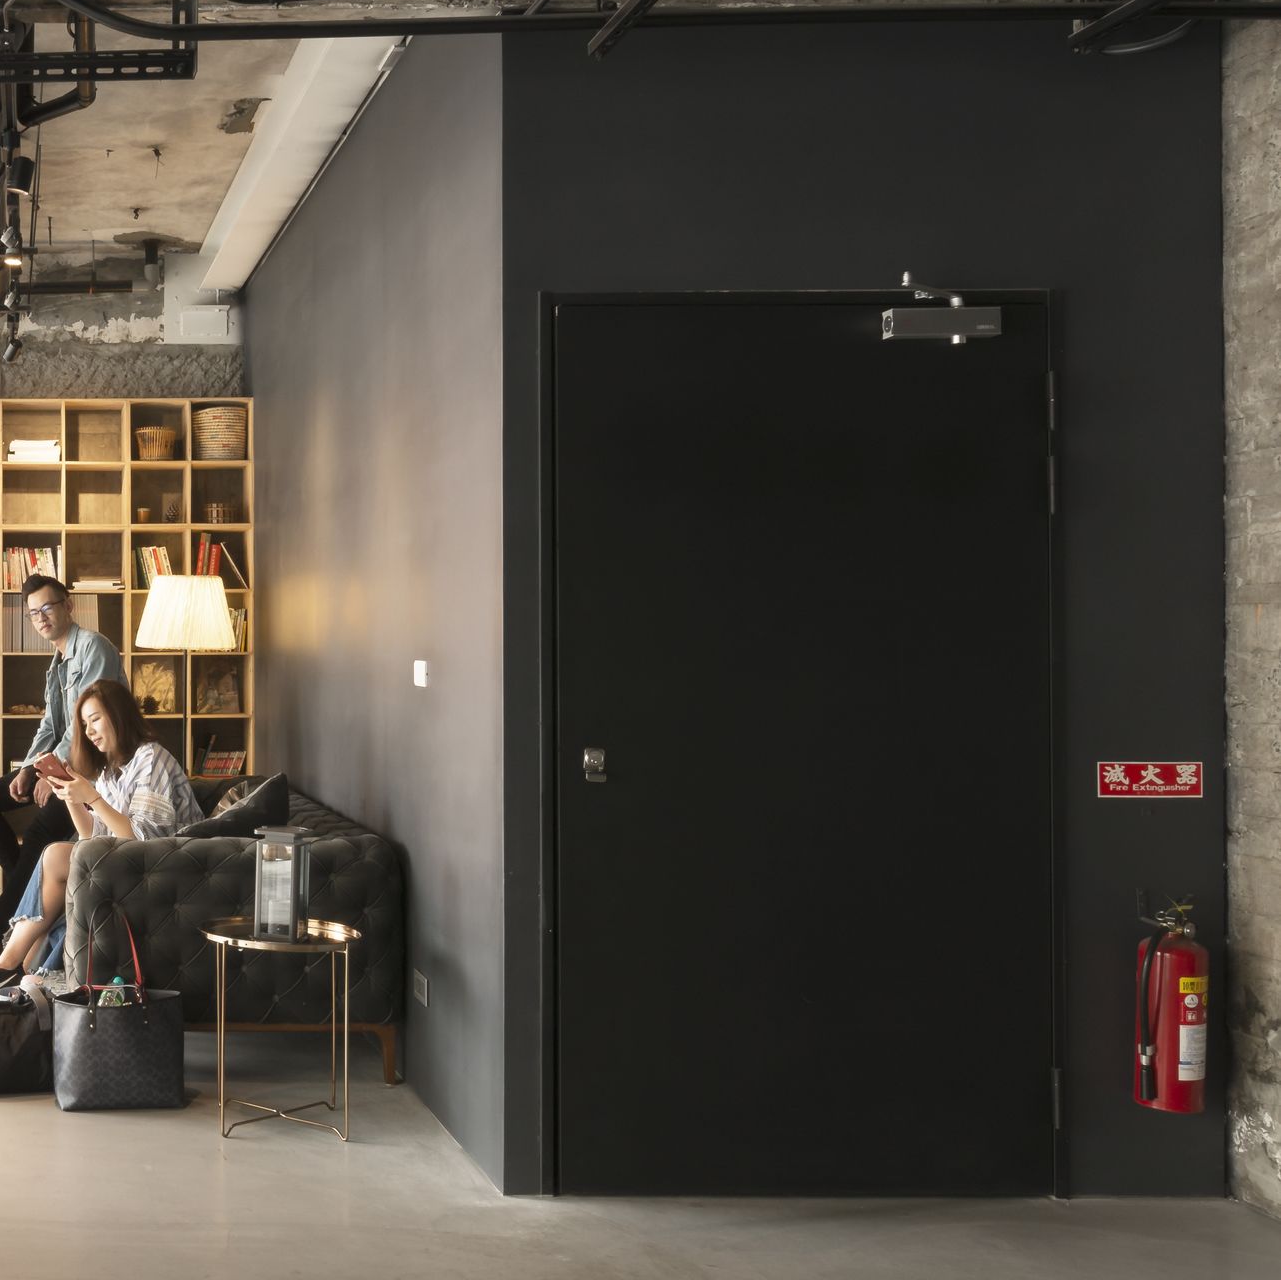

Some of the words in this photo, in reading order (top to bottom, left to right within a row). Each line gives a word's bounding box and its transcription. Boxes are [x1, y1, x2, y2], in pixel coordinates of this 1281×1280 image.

[1102, 764, 1198, 785] 滅火器
[1132, 784, 1191, 792] Extinguisher
